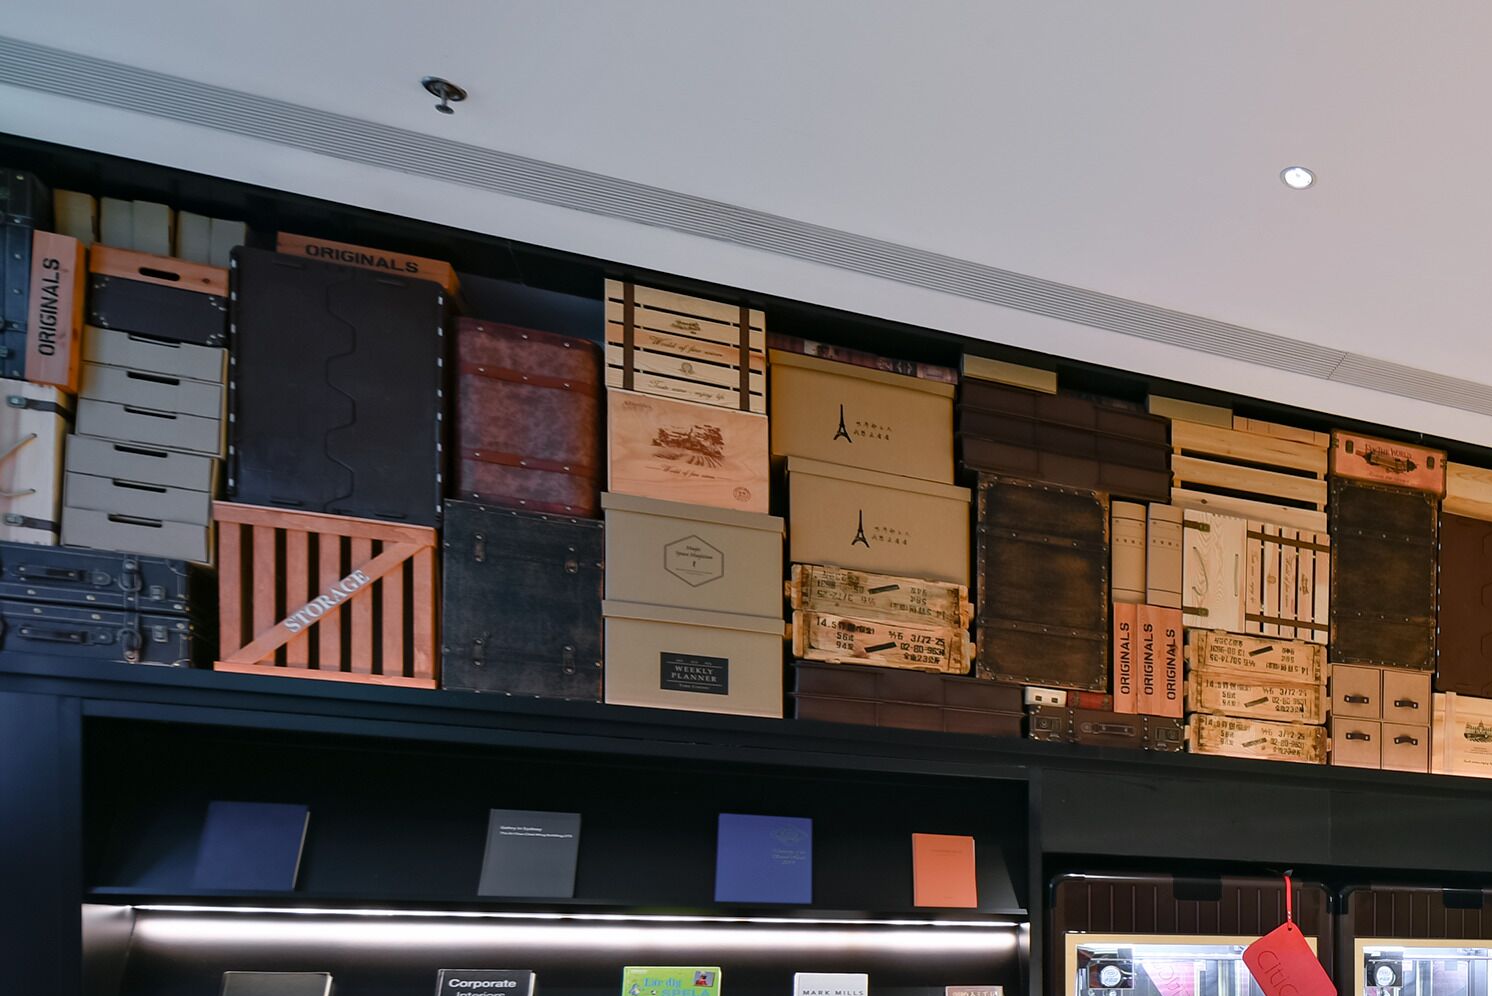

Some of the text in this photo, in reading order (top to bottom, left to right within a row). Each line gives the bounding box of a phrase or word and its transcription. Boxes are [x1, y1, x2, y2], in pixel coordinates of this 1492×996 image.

[305, 243, 419, 274] ORIGINALS
[37, 257, 61, 357] ORIGINALS
[283, 569, 371, 633] STORAGE
[910, 633, 946, 646] 3/72-25
[1119, 622, 1131, 695] ORIGINALS
[1143, 623, 1154, 696] ORIGINALS
[671, 671, 717, 683] PLANNER
[674, 664, 714, 676] WEEKLY
[1166, 628, 1176, 701] ORIGINALS
[448, 978, 517, 989] Corporate
